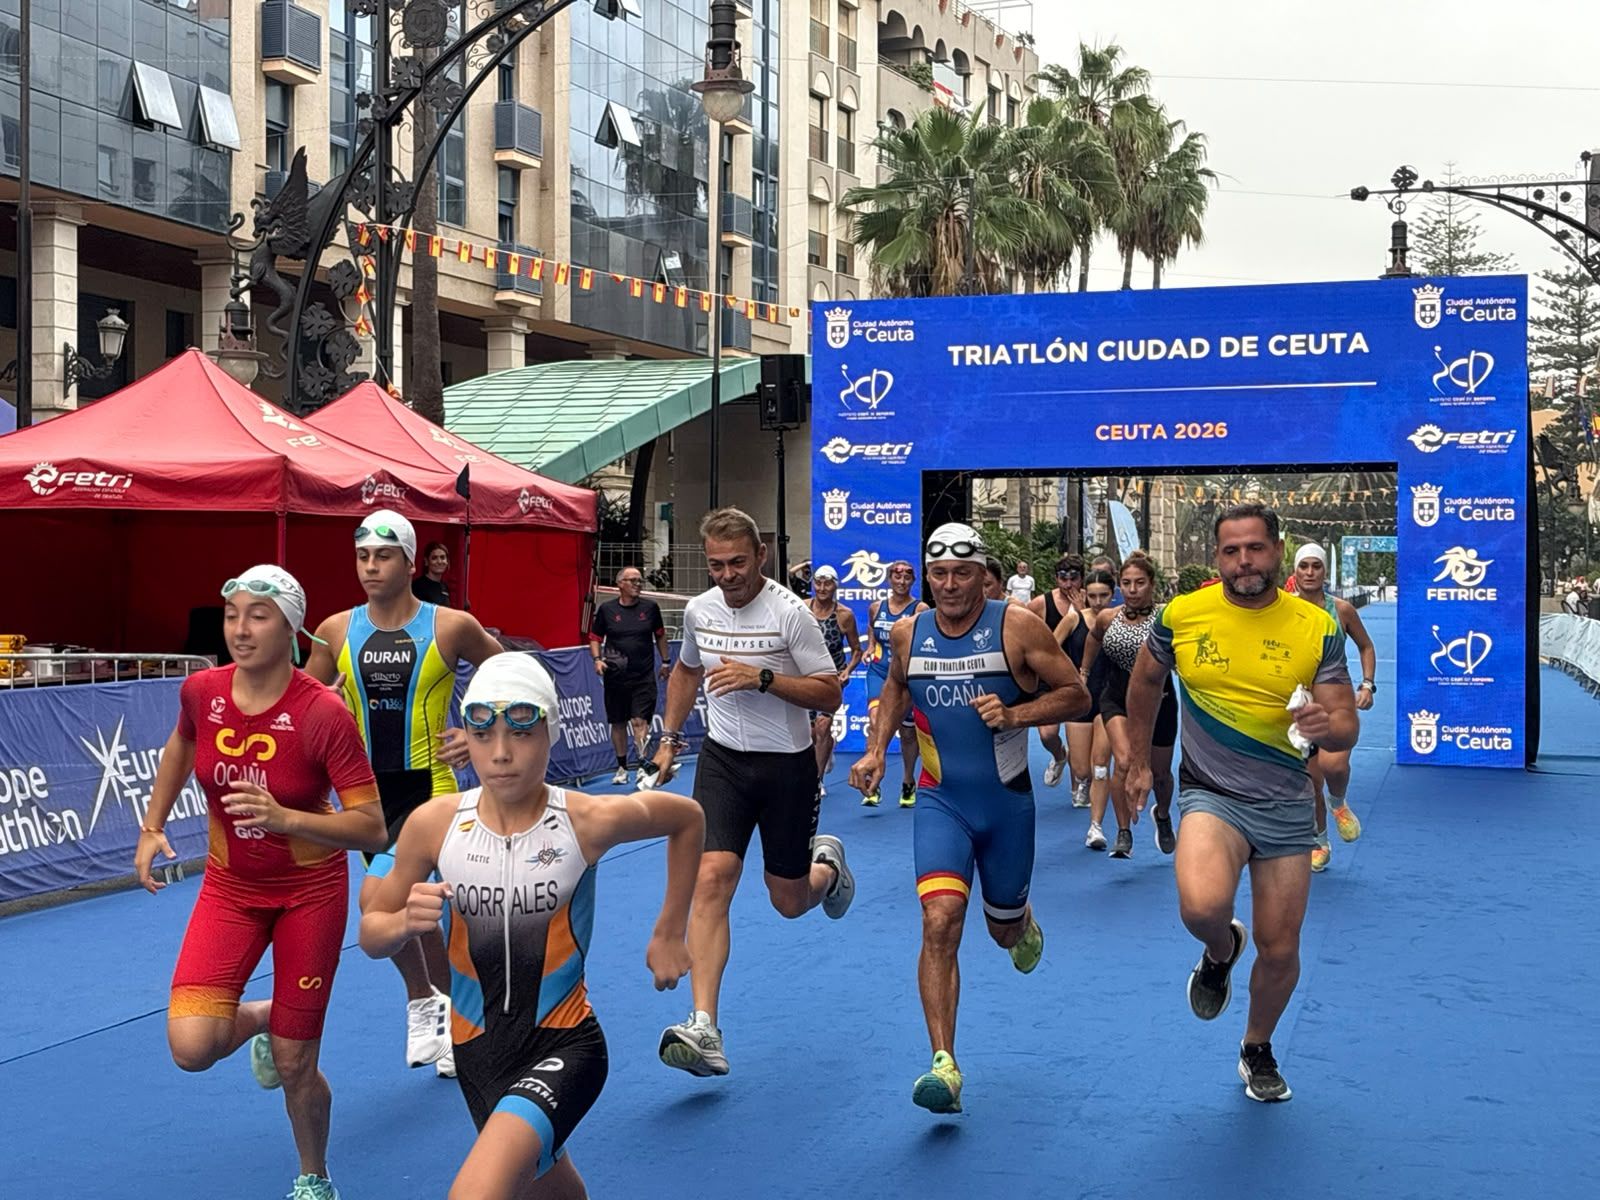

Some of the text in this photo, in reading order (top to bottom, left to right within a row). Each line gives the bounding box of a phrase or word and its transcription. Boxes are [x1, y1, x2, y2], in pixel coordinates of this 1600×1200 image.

[1446, 297, 1516, 307] Ciudad Autónoma
[1446, 307, 1516, 322] de Ceuta
[853, 319, 914, 328] Ciudad Autónoma
[853, 327, 914, 342] de Ceuta
[948, 332, 1370, 366] TRIATLÓN CIUDAD DE CEUTA
[1095, 422, 1228, 441] CEUTA 2026
[876, 502, 911, 510] Autónoma
[1444, 497, 1515, 505] Ciudad Autónoma
[863, 510, 912, 525] Ceuta
[1444, 506, 1515, 521] de Ceuta
[1427, 588, 1497, 601] FETRICE
[703, 637, 774, 649] VAN RYSEL
[363, 650, 411, 664] DURAN
[1442, 725, 1512, 734] Ciudad Autónoma
[1442, 733, 1512, 750] de Ceuta
[115, 744, 165, 782] Eur
[0, 767, 49, 808] ope
[466, 853, 490, 864] TACTIC
[456, 880, 559, 917] CORRALES
